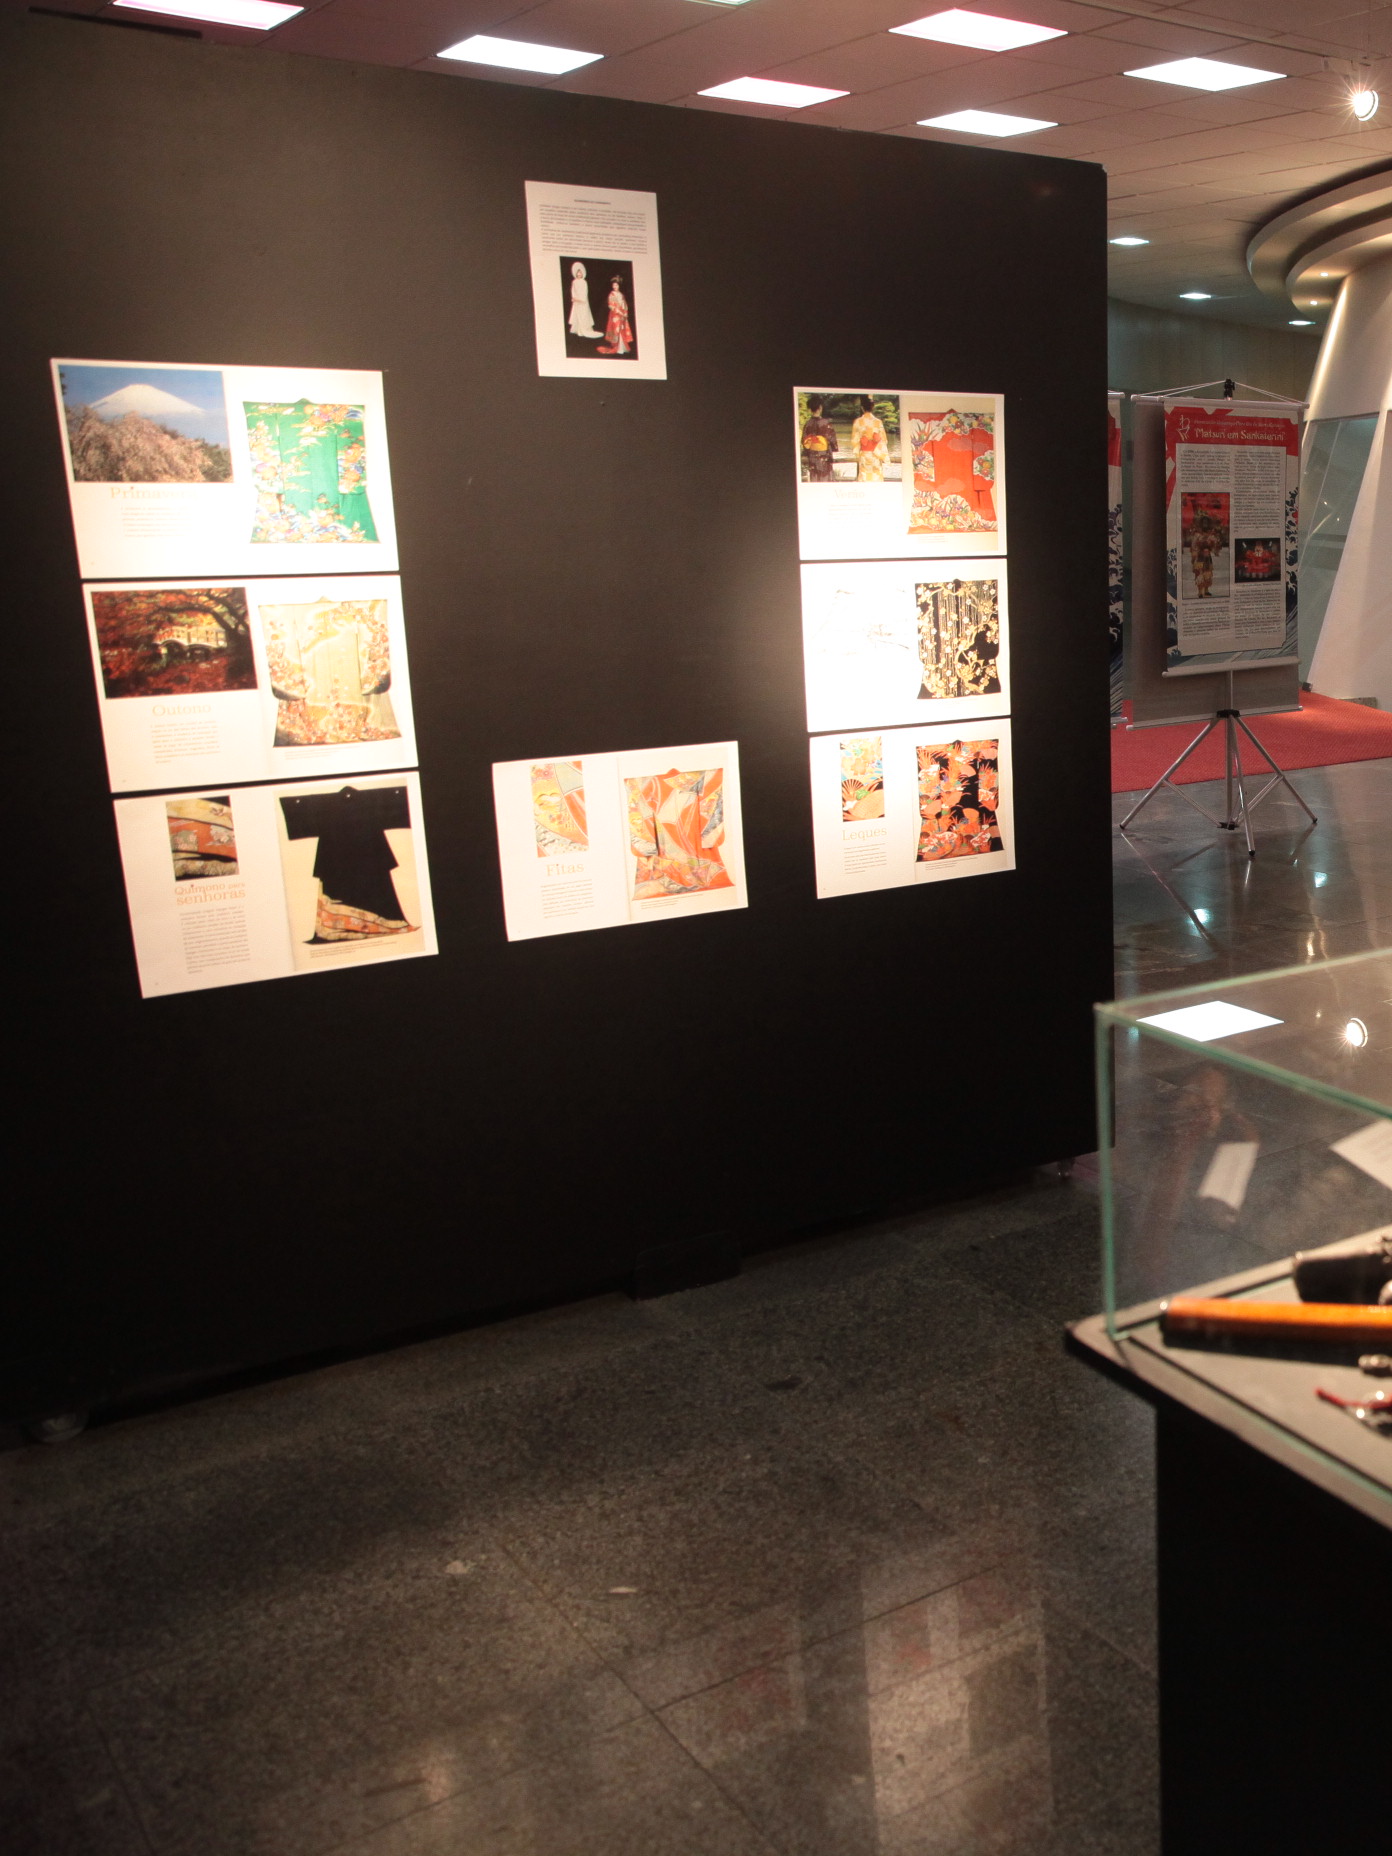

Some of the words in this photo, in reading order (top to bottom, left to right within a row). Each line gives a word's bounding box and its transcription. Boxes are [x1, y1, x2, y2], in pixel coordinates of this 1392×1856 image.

[152, 703, 212, 717] Outono
[842, 827, 887, 841] Leques
[545, 863, 584, 876] Fitas
[174, 883, 226, 896] Quimono
[176, 889, 246, 906] senhoras
